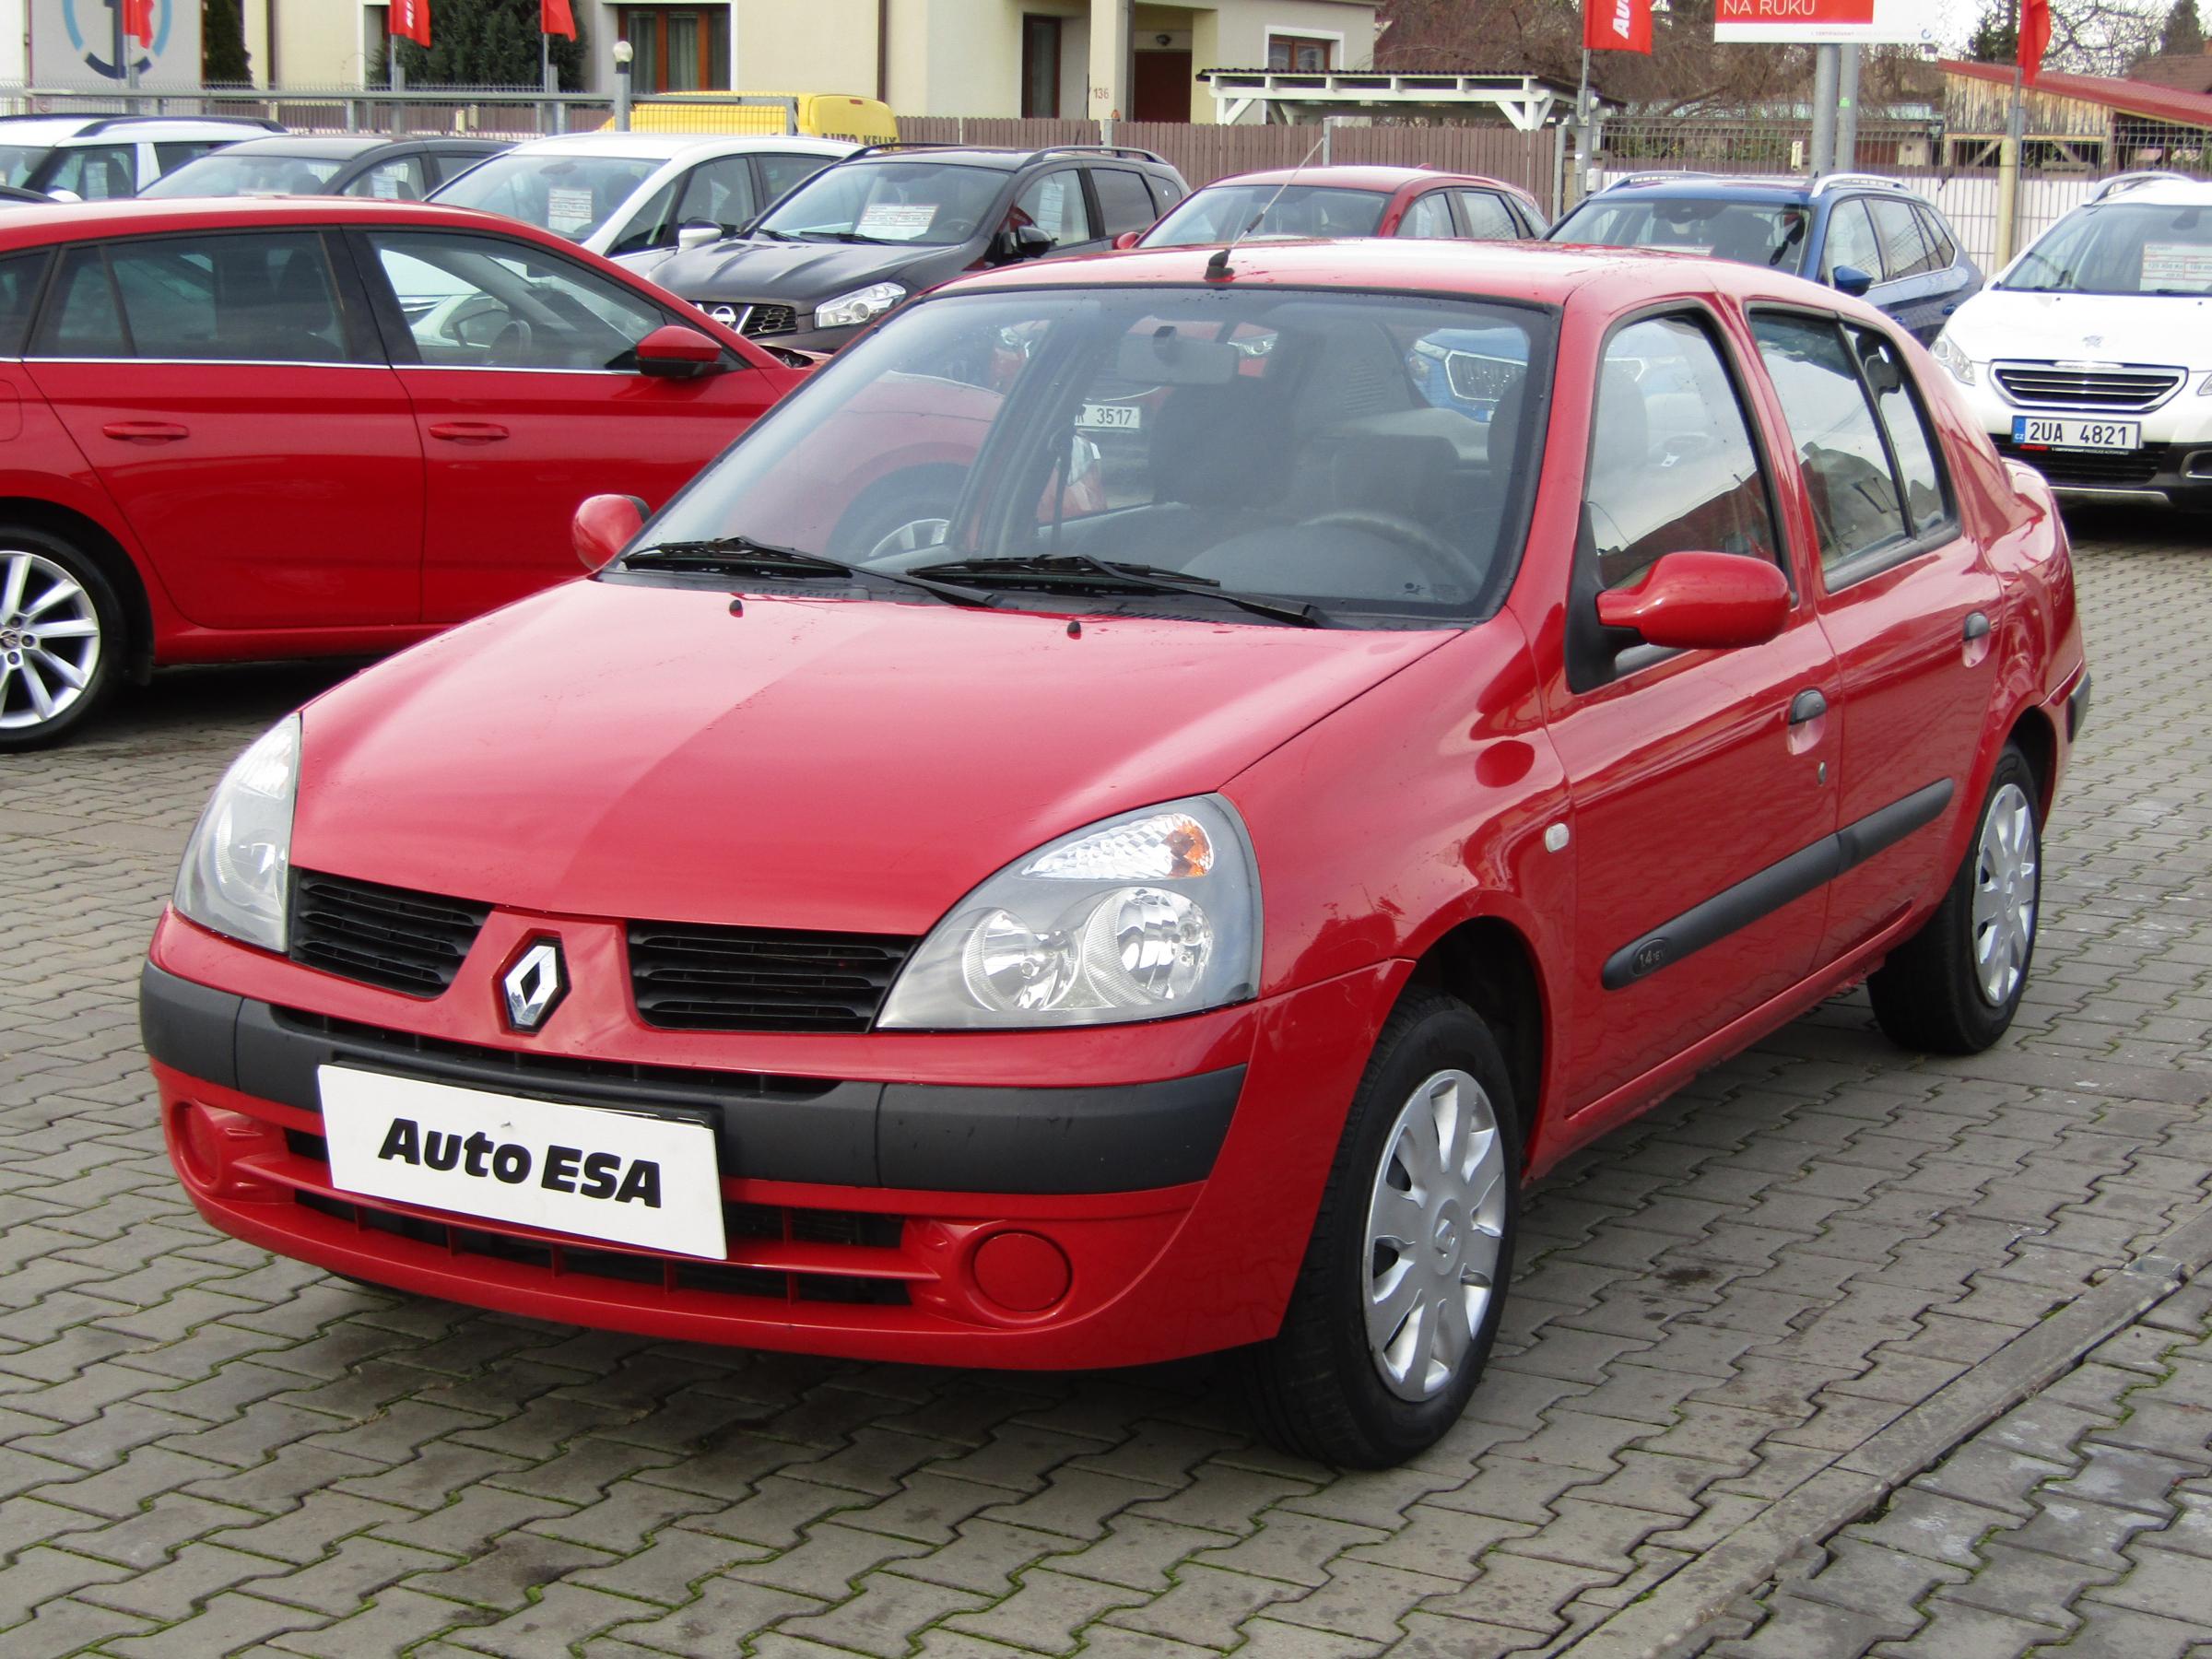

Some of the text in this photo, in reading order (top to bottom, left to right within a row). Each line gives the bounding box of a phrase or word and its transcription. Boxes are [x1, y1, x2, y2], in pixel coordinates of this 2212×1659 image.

[1723, 0, 1816, 16] NA RUKU
[1613, 0, 1630, 40] Au
[1093, 88, 1110, 100] 136
[1097, 407, 1133, 425] 3517
[2029, 421, 2064, 442] 2UA
[2079, 424, 2127, 445] 4821
[378, 1117, 662, 1208] Auto ESA
